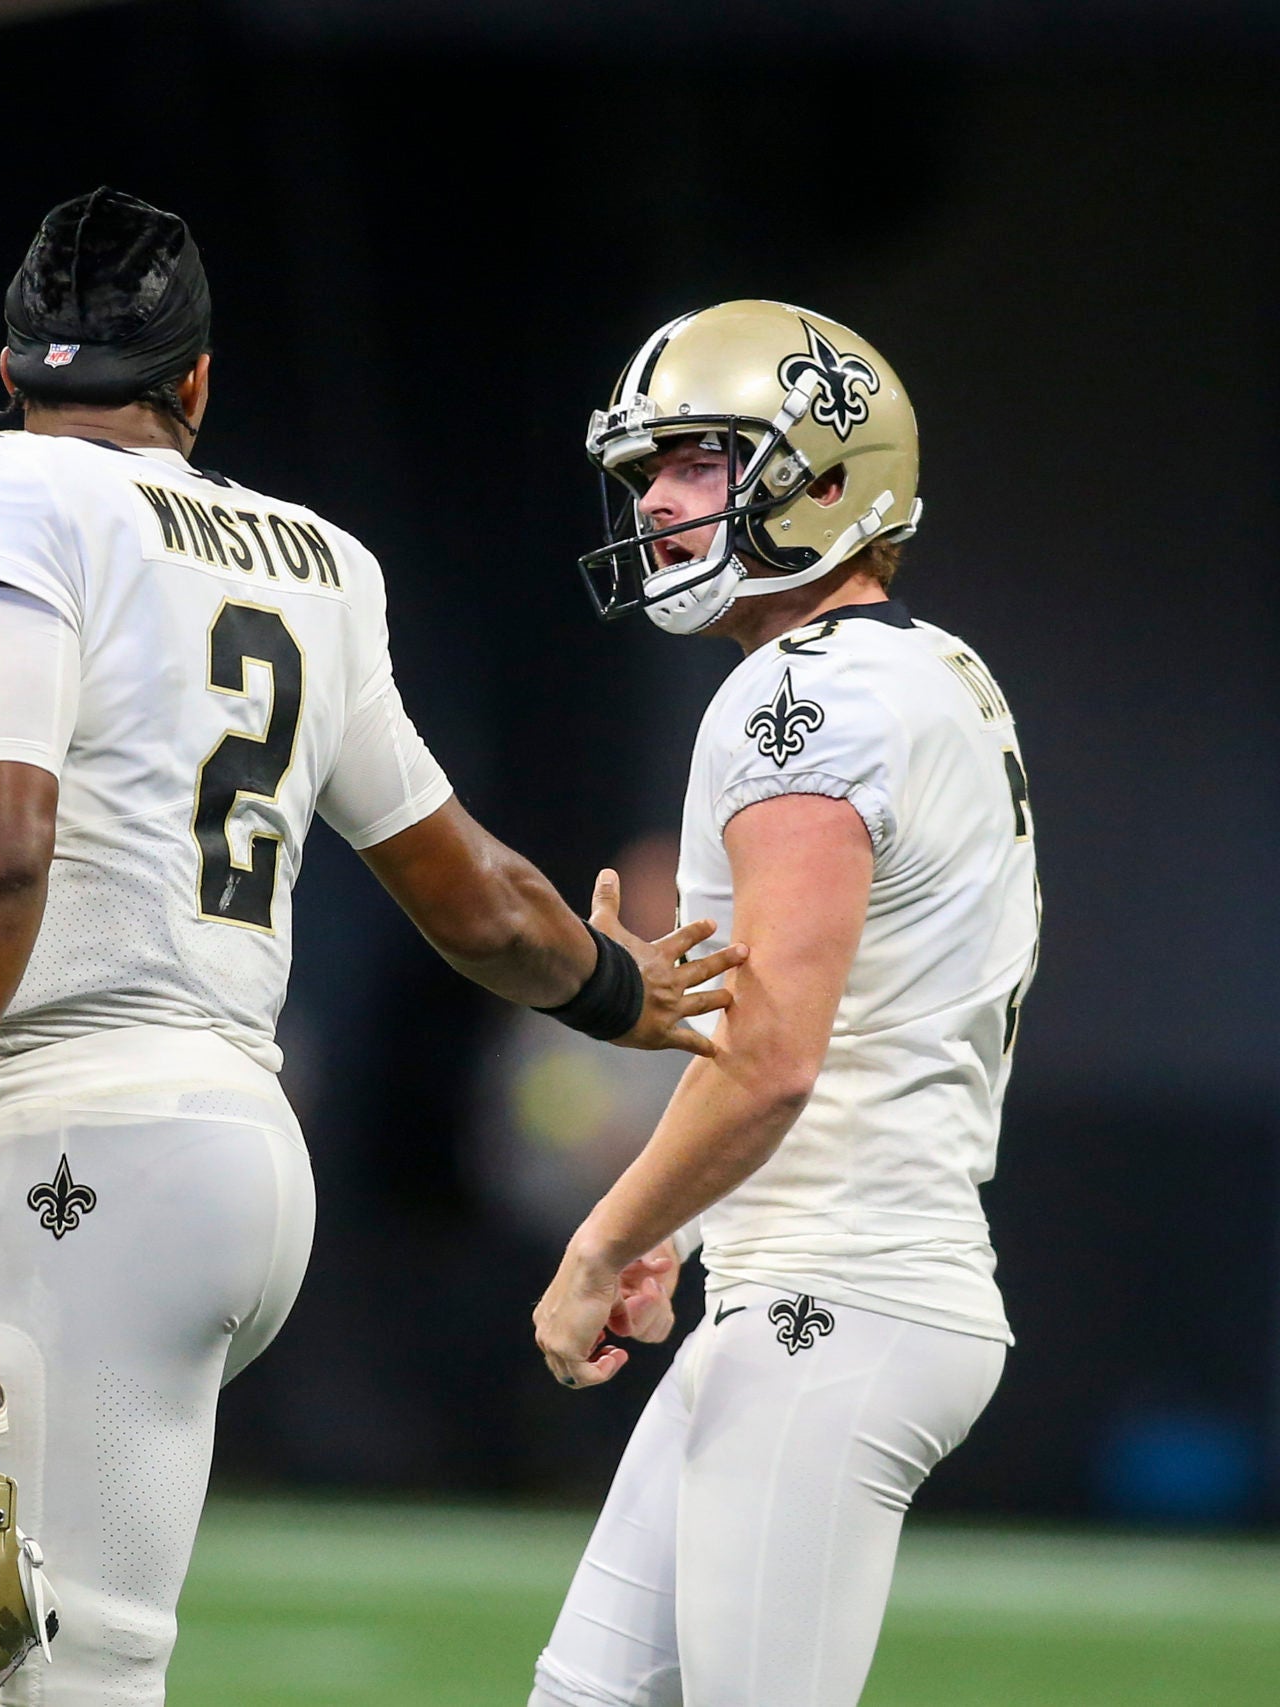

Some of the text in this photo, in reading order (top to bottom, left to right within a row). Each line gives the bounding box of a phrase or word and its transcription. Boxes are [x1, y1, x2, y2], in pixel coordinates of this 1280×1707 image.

[50, 352, 71, 363] NFL
[129, 479, 345, 592] WINSTON
[190, 595, 307, 936] 2
